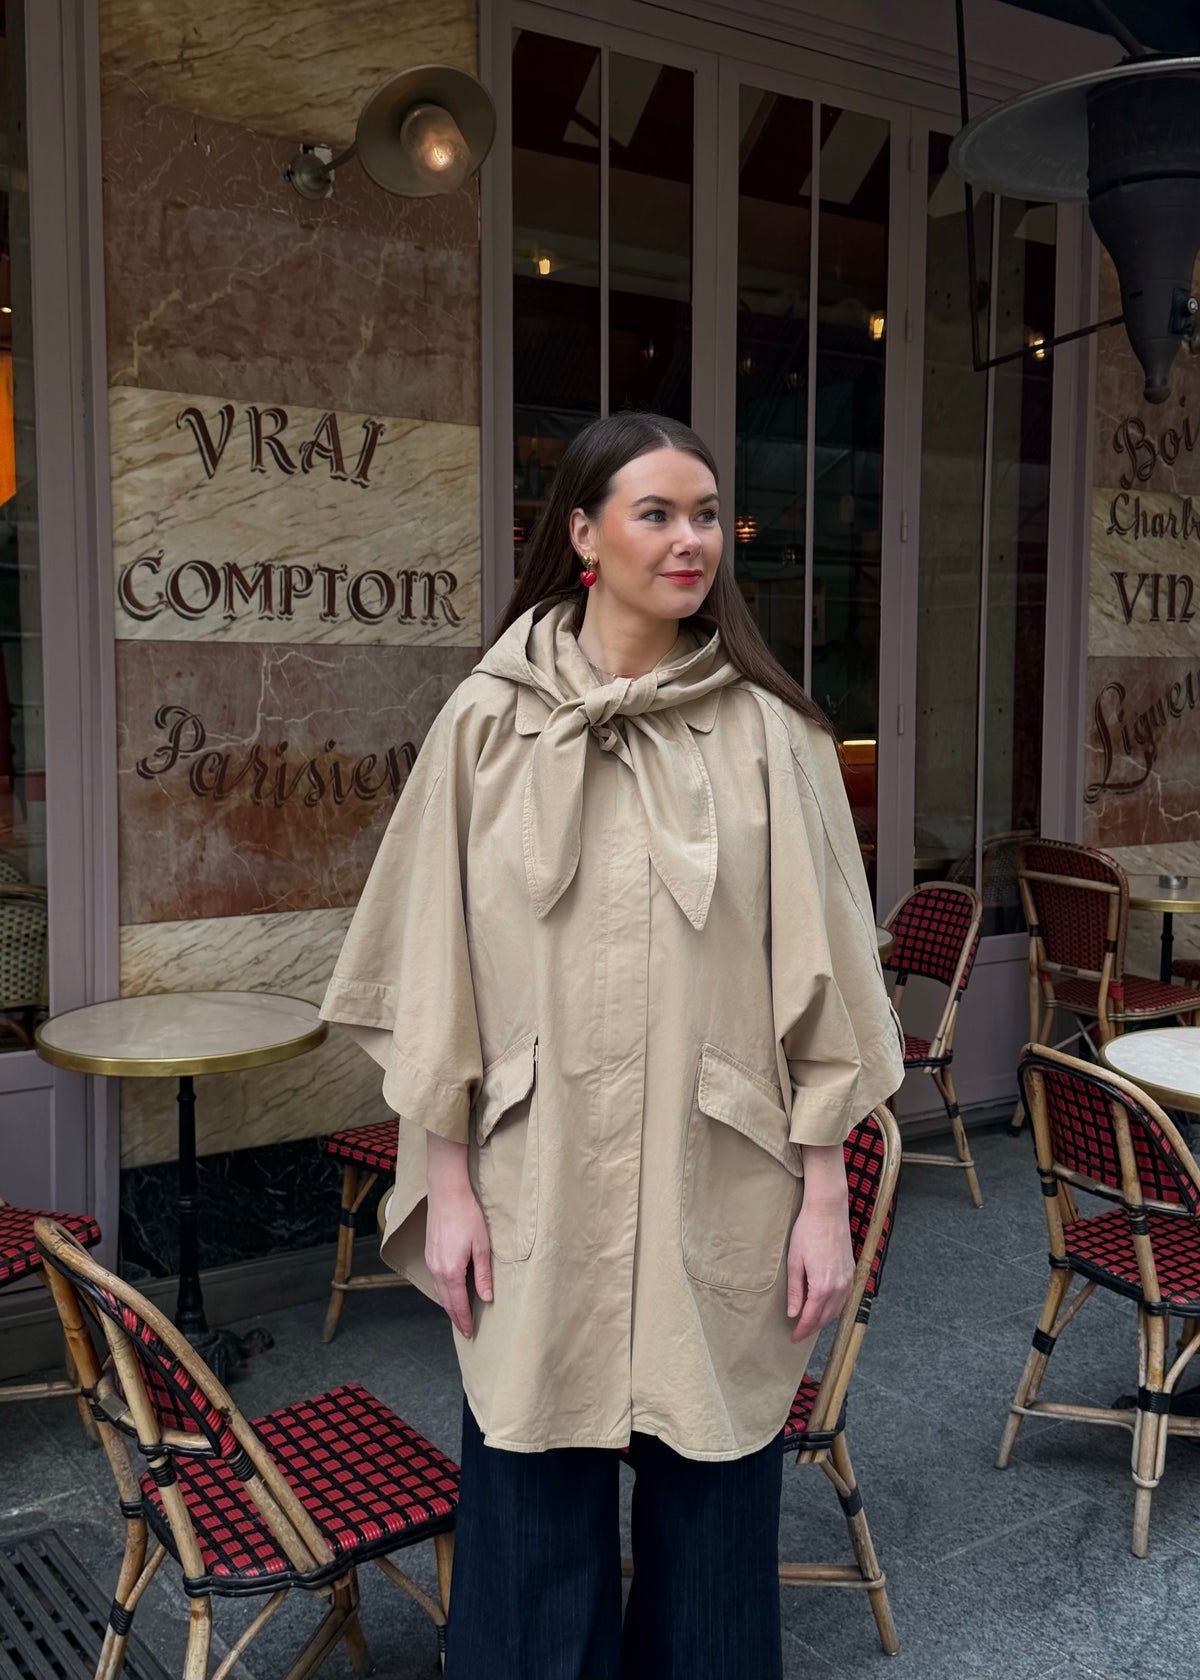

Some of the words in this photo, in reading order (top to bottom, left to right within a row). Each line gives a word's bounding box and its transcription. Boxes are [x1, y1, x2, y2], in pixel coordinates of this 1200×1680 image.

[176, 404, 386, 488] VRAI
[118, 550, 466, 628] COMPTOIR
[1110, 571, 1195, 625] VIN
